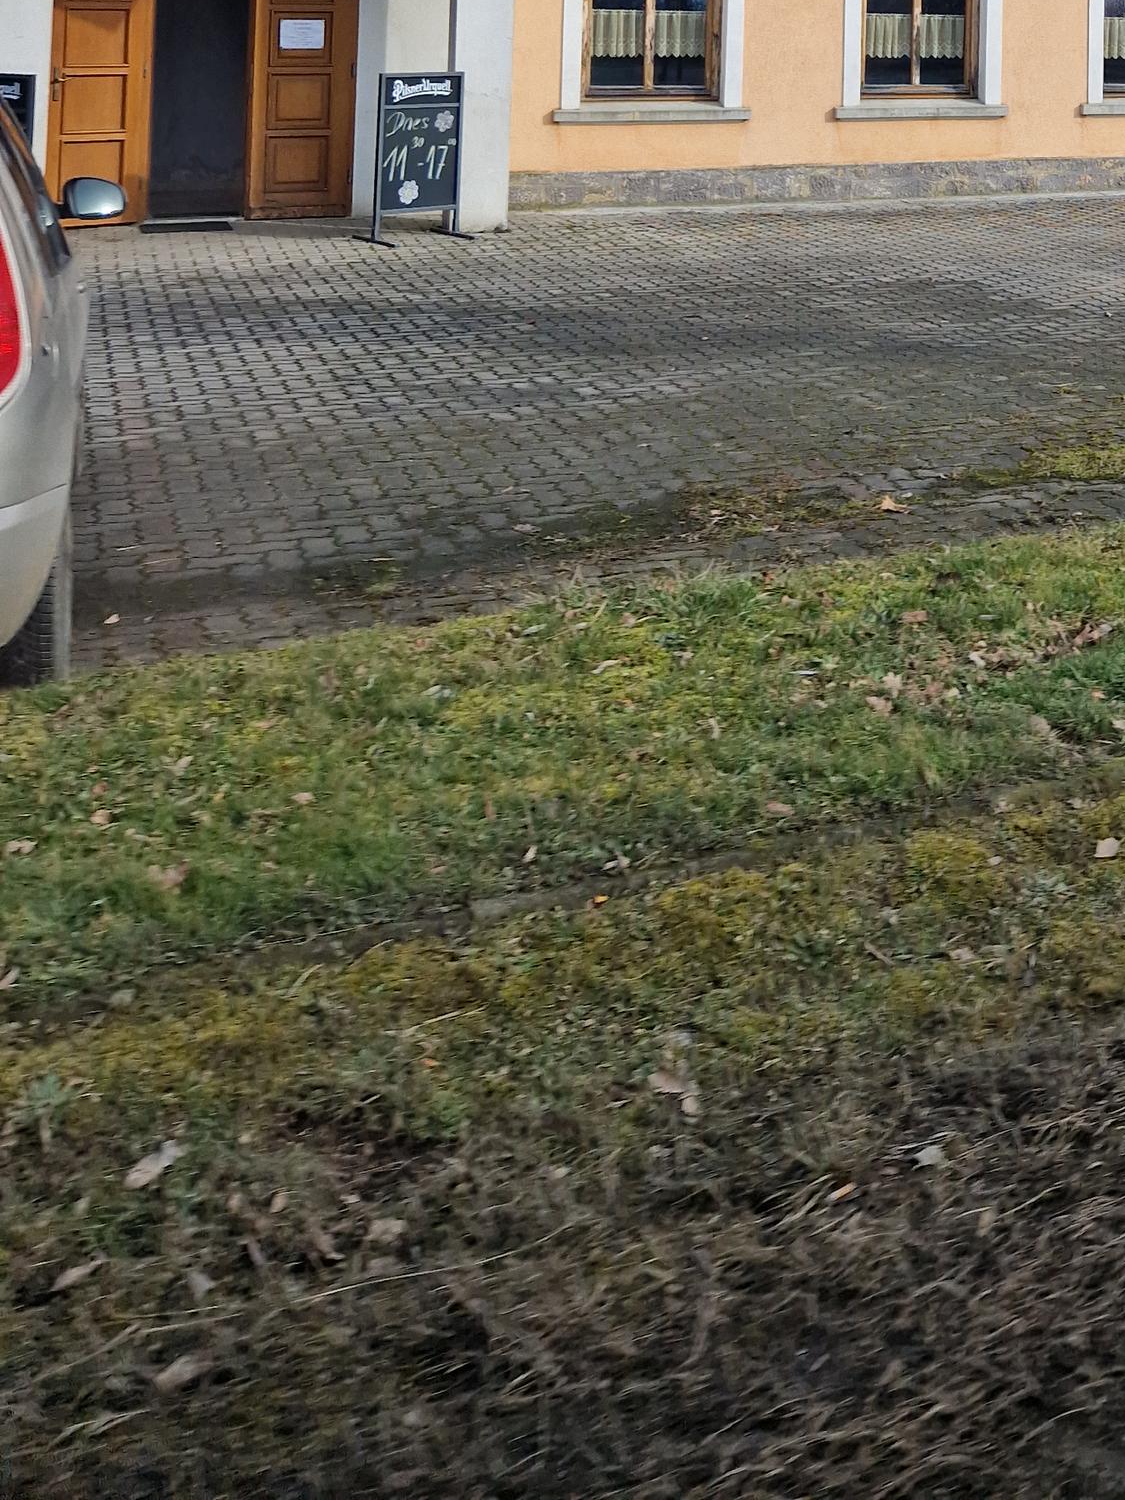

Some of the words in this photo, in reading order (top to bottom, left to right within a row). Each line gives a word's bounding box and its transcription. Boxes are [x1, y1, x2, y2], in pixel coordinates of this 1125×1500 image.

[392, 80, 422, 102] Pilsner
[422, 78, 452, 96] Urquell
[386, 111, 430, 137] Dnes
